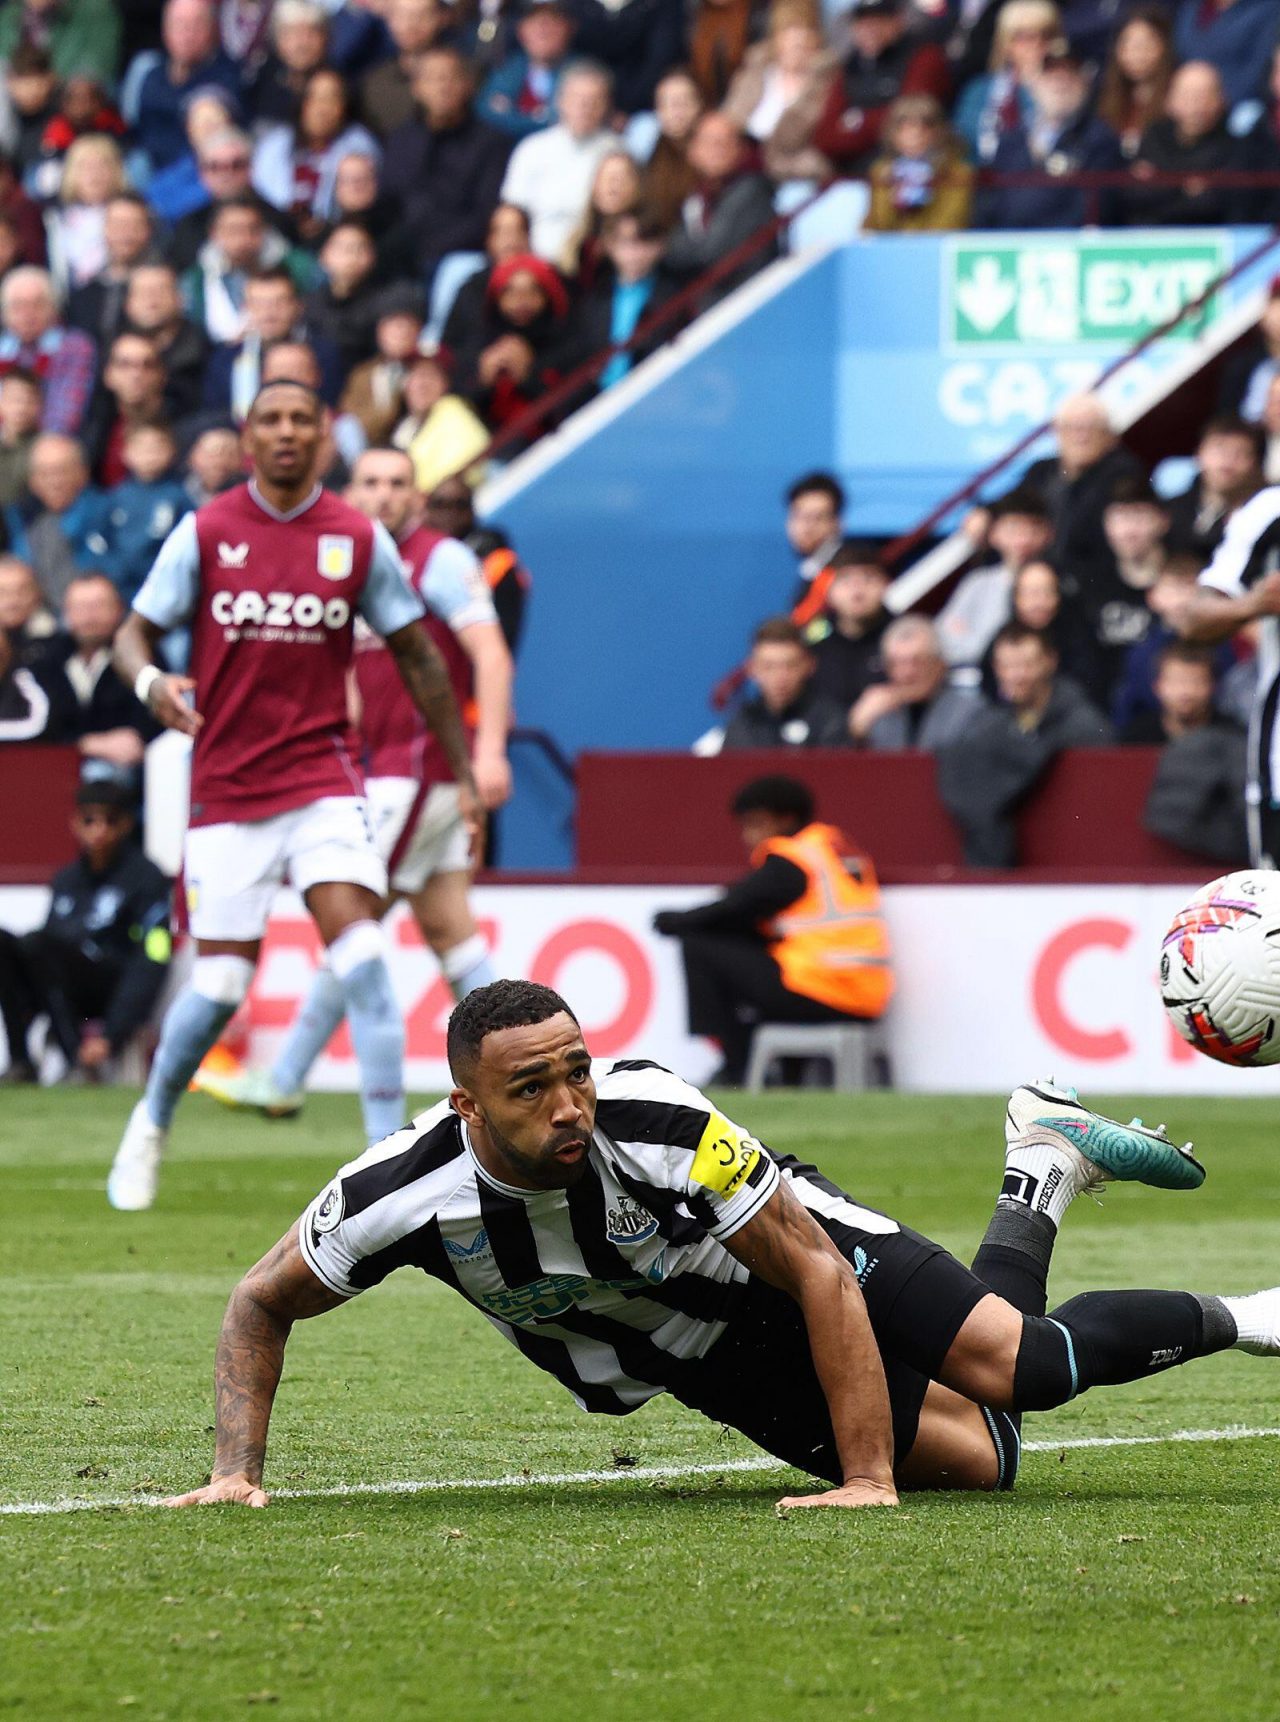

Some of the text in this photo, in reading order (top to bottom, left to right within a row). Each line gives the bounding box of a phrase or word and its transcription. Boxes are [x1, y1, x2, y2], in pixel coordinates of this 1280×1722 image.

[1085, 261, 1213, 327] EXIT
[212, 590, 350, 630] CAZOO
[858, 1257, 879, 1289] ASTORE
